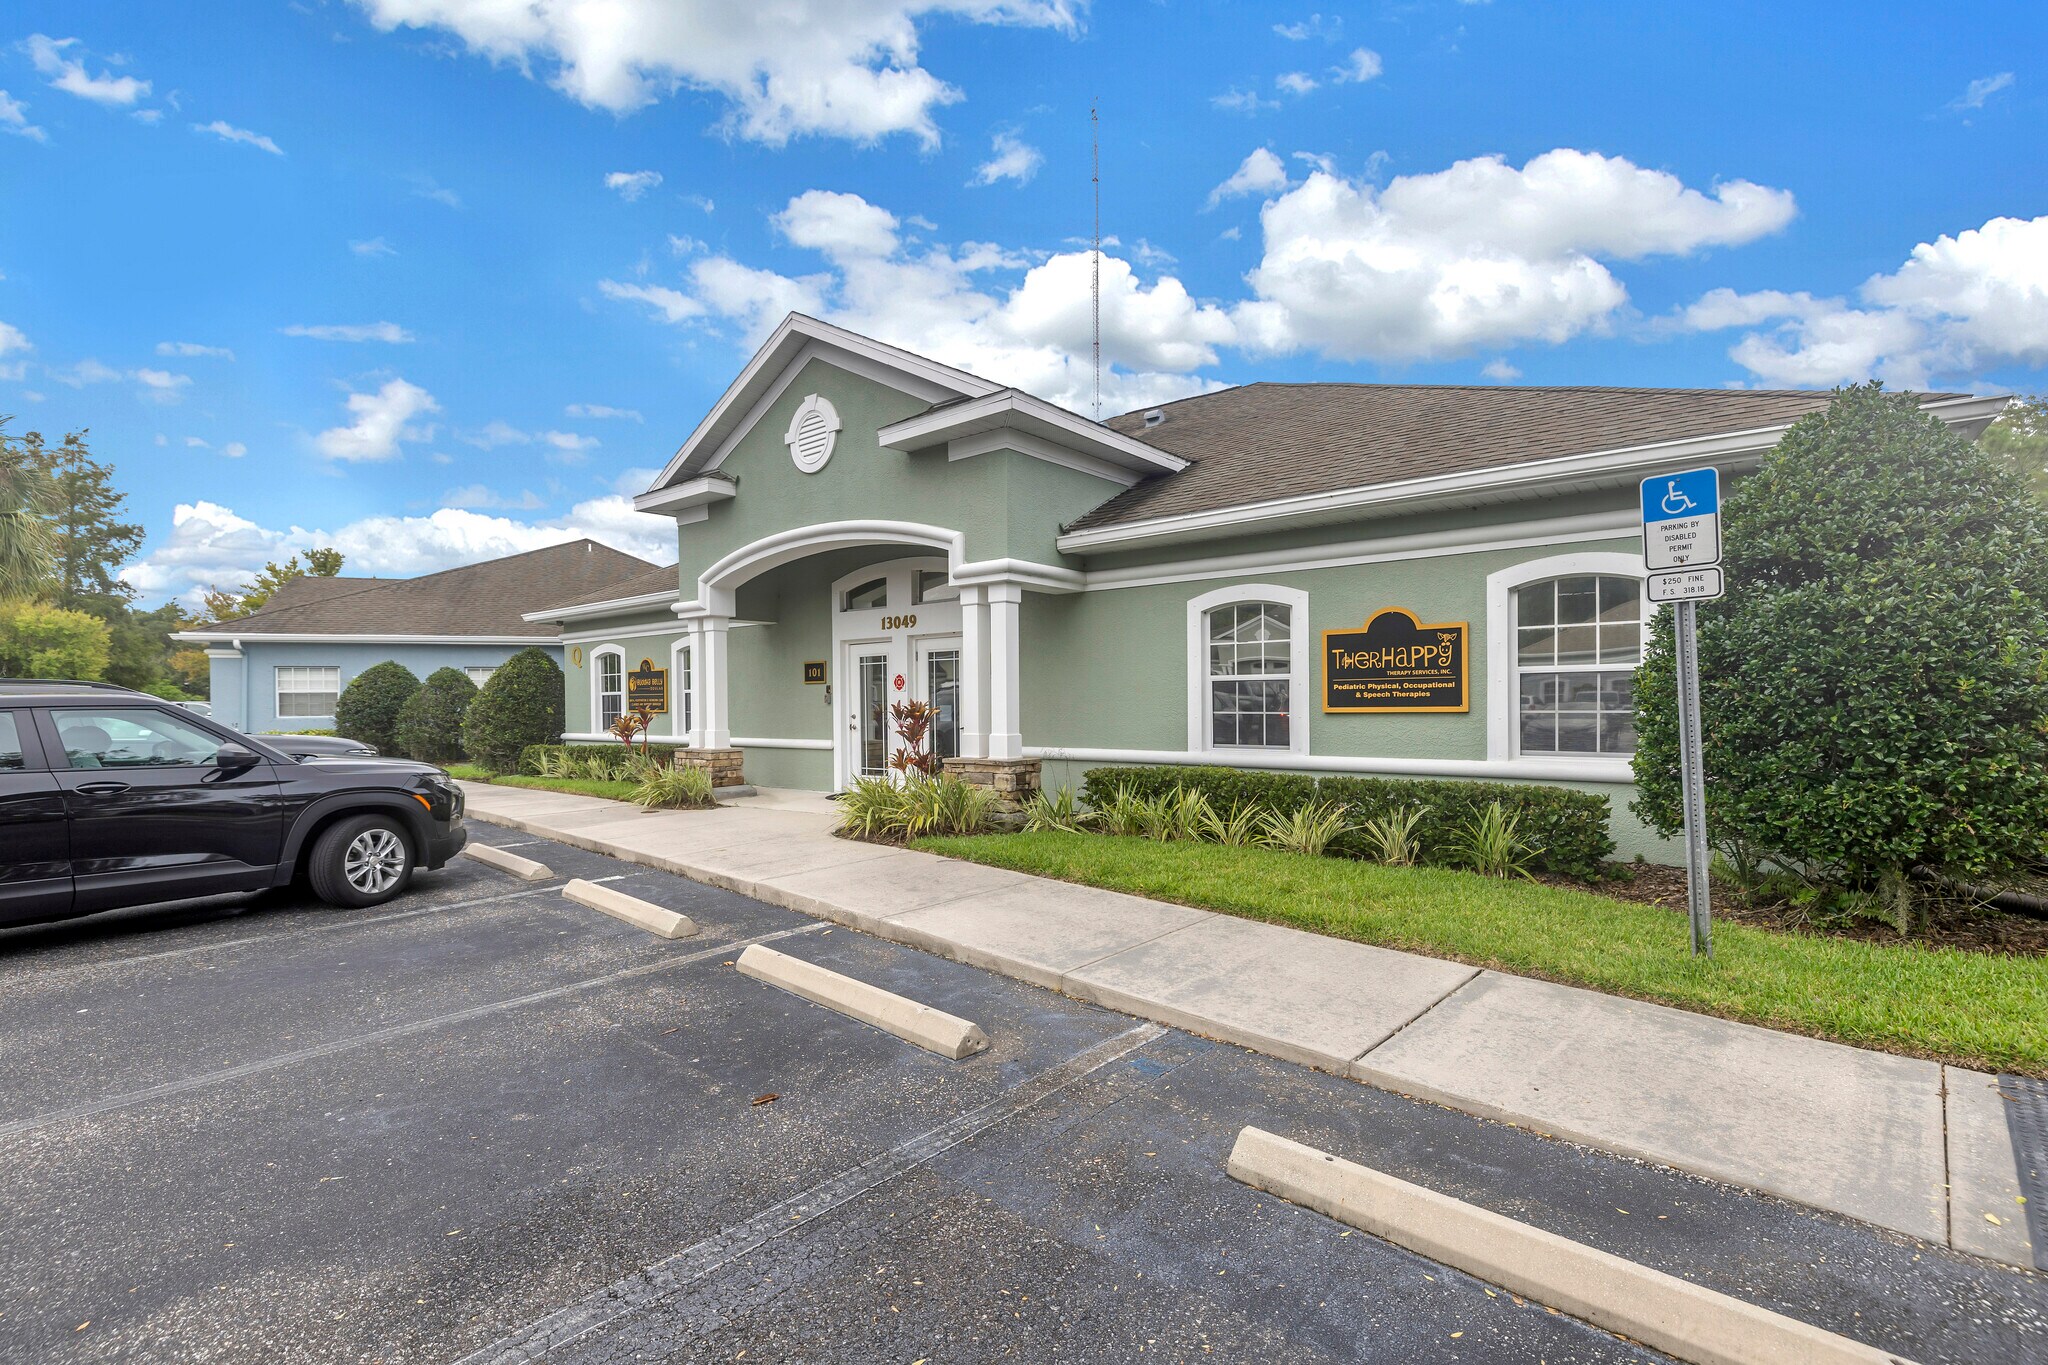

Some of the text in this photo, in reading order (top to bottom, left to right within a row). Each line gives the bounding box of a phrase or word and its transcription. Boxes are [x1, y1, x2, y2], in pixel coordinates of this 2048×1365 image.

[1661, 523, 1688, 531] PARKING
[1665, 532, 1696, 542] DISABLED
[1669, 544, 1692, 552] PERMIT
[1673, 555, 1690, 563] ONLY
[1663, 577, 1681, 585] $250
[1683, 586, 1705, 594] 318.18
[881, 614, 917, 630] 13049
[808, 667, 821, 678] 101
[1367, 683, 1402, 691] Physical,
[1363, 691, 1391, 699] Speech
